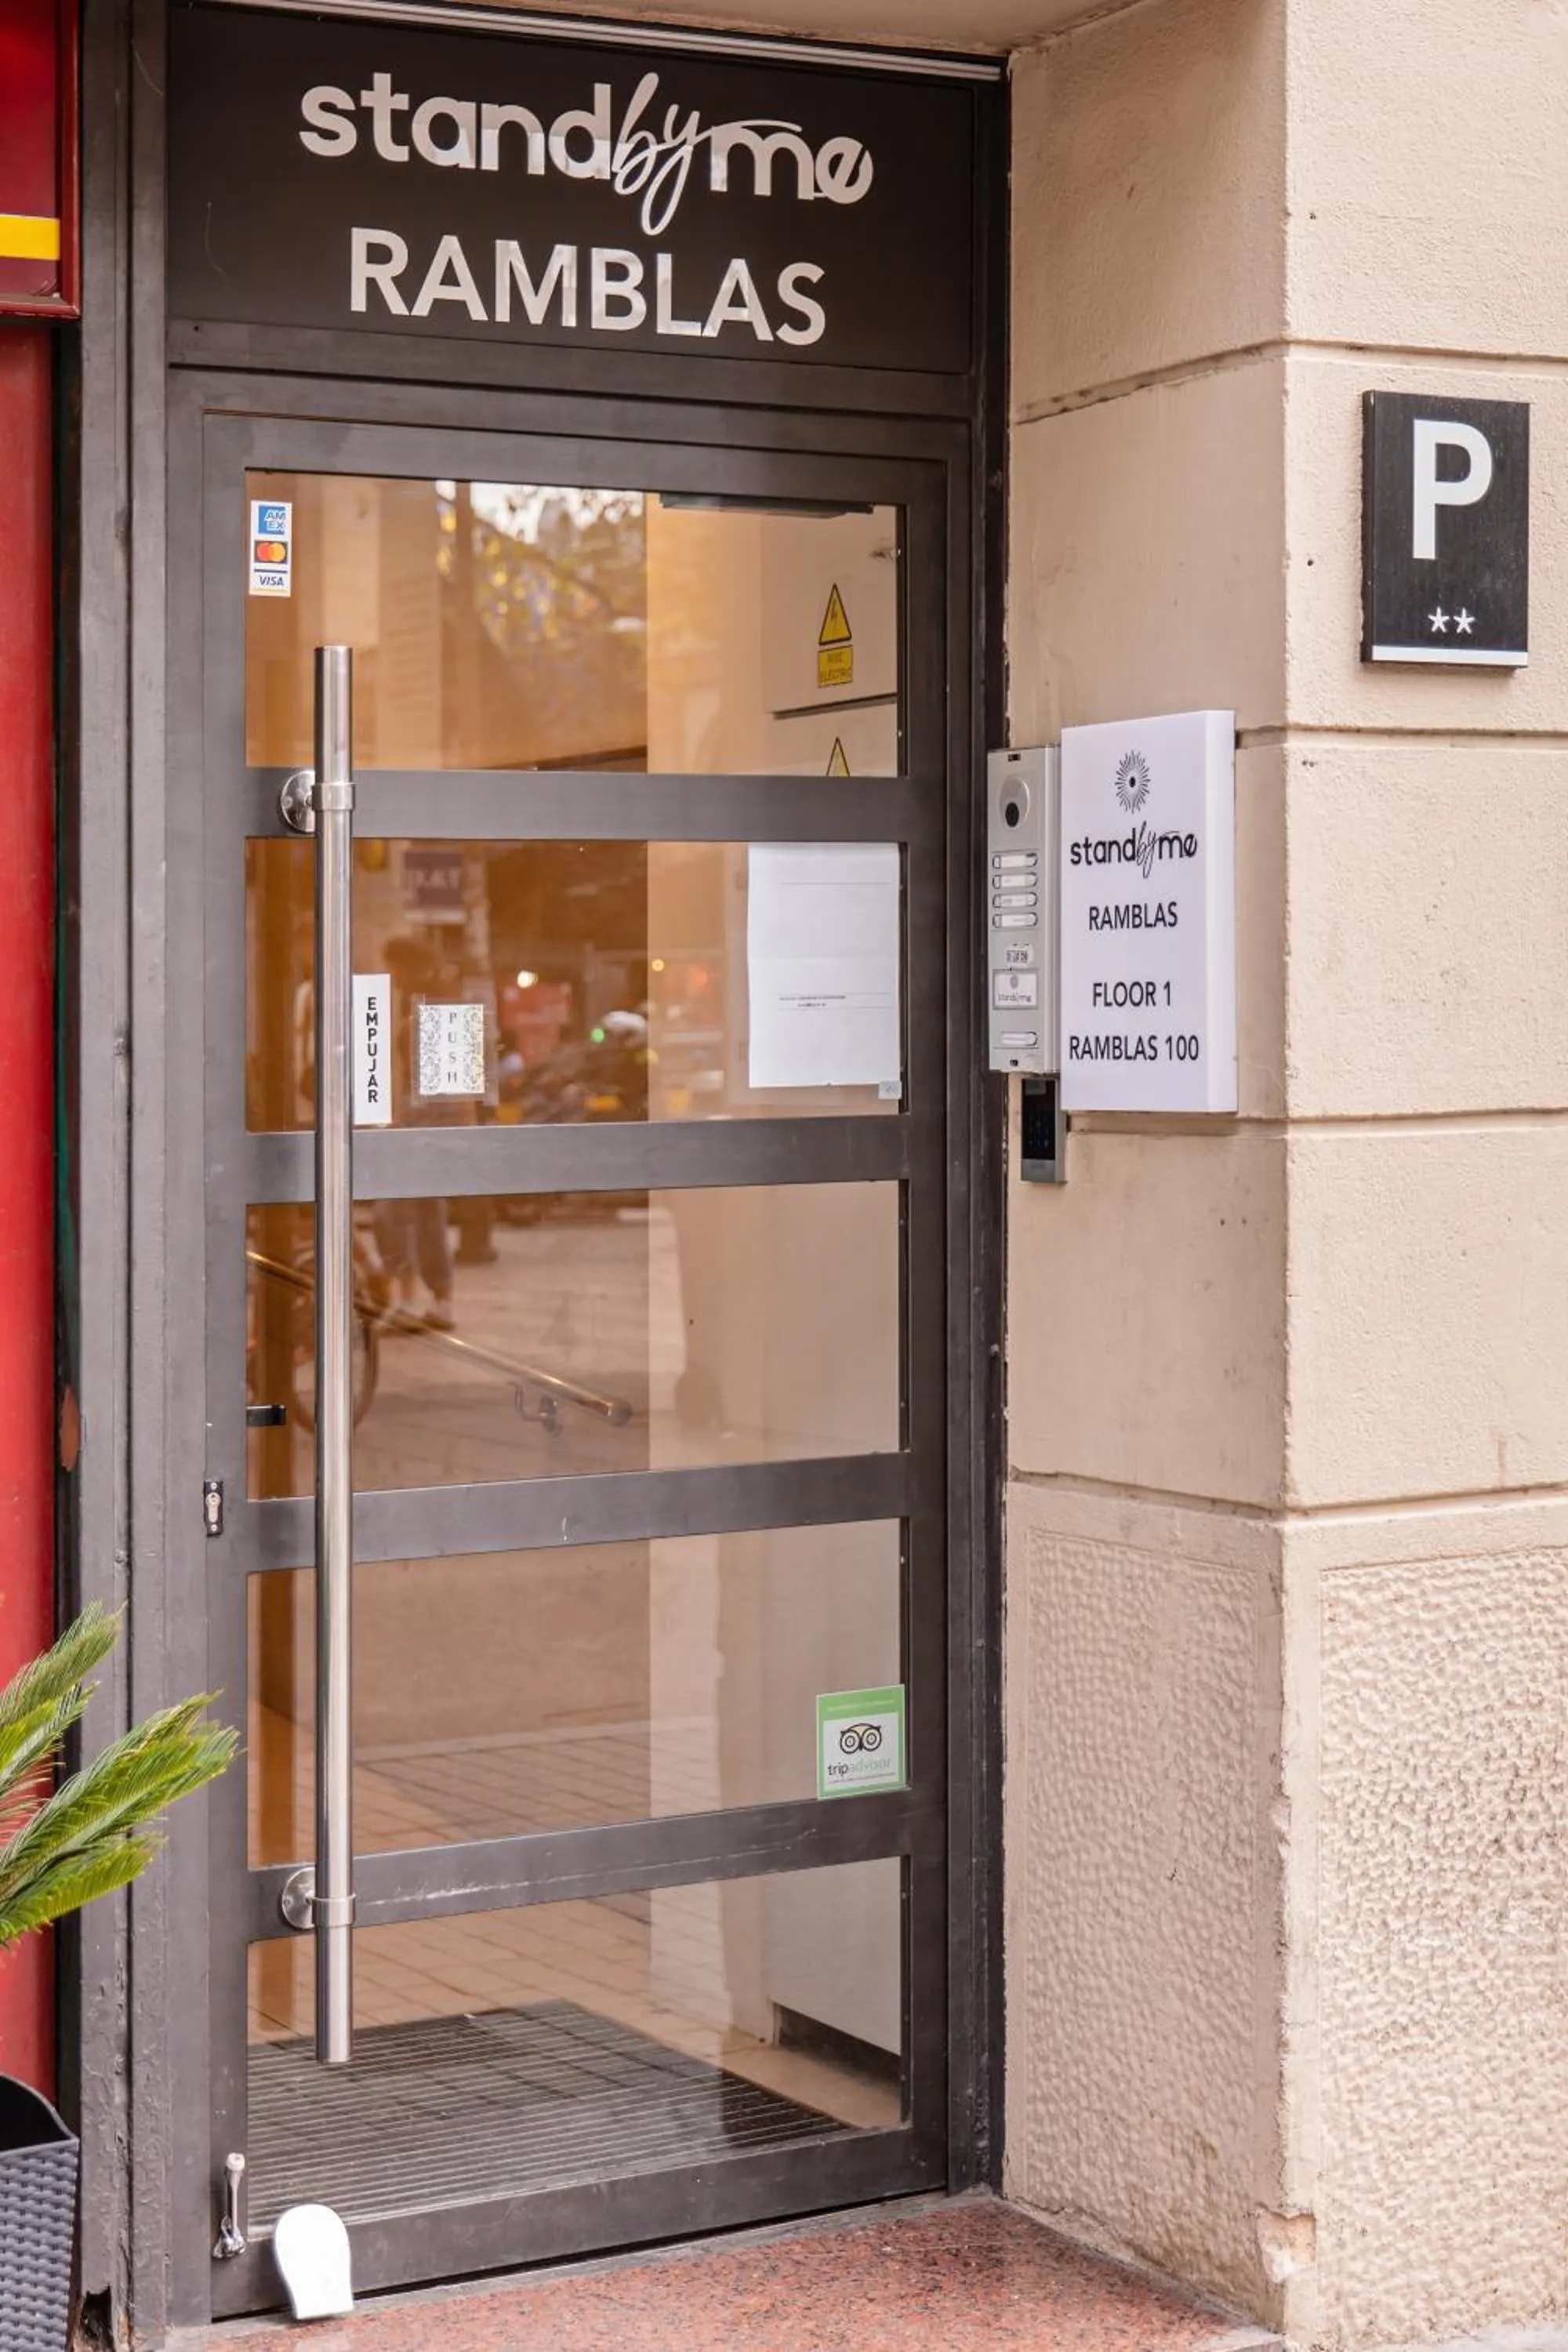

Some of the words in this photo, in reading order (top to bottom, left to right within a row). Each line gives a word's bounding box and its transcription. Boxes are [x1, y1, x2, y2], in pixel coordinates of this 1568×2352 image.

[350, 227, 826, 346] RAMBLAS
[1412, 419, 1491, 560] P
[264, 510, 286, 521] AM
[260, 575, 284, 586] VISA
[1088, 901, 1178, 931] RAMBLAS
[1093, 982, 1156, 1007] FLOOR
[1163, 981, 1171, 1007] 1
[366, 996, 379, 1103] EMPUJAR
[448, 1012, 457, 1083] PUSH
[1069, 1035, 1158, 1061] RAMBLAS
[1165, 1035, 1200, 1061] 100
